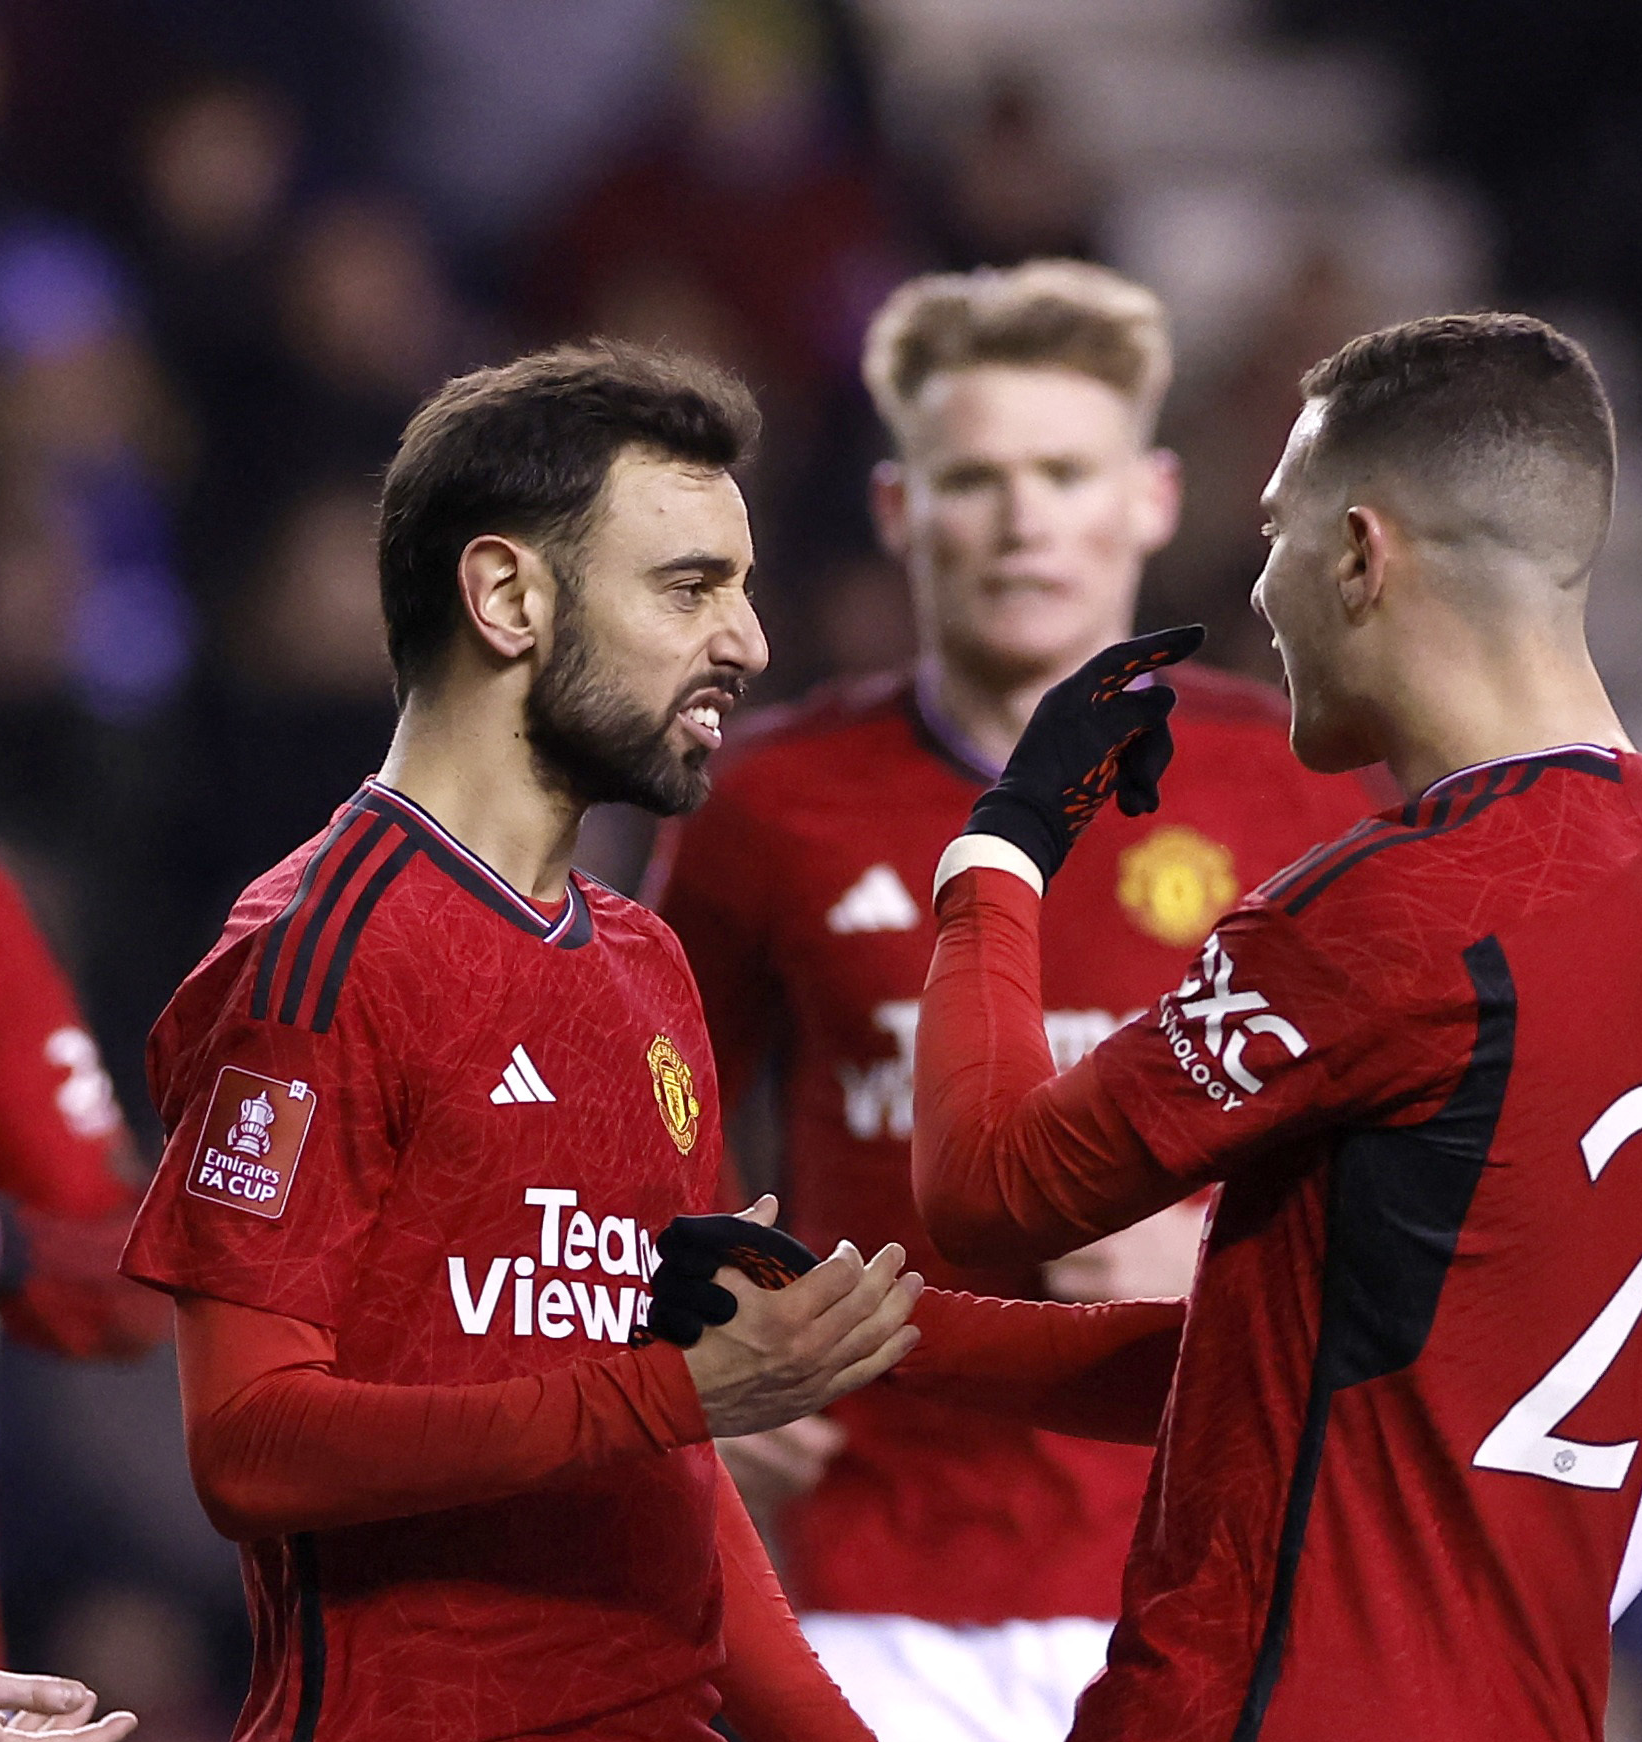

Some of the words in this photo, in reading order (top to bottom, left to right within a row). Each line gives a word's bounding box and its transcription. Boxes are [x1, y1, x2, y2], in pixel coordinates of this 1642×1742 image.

[198, 1166, 224, 1190] FA
[228, 1176, 277, 1202] CUP
[205, 1148, 280, 1184] Emirates
